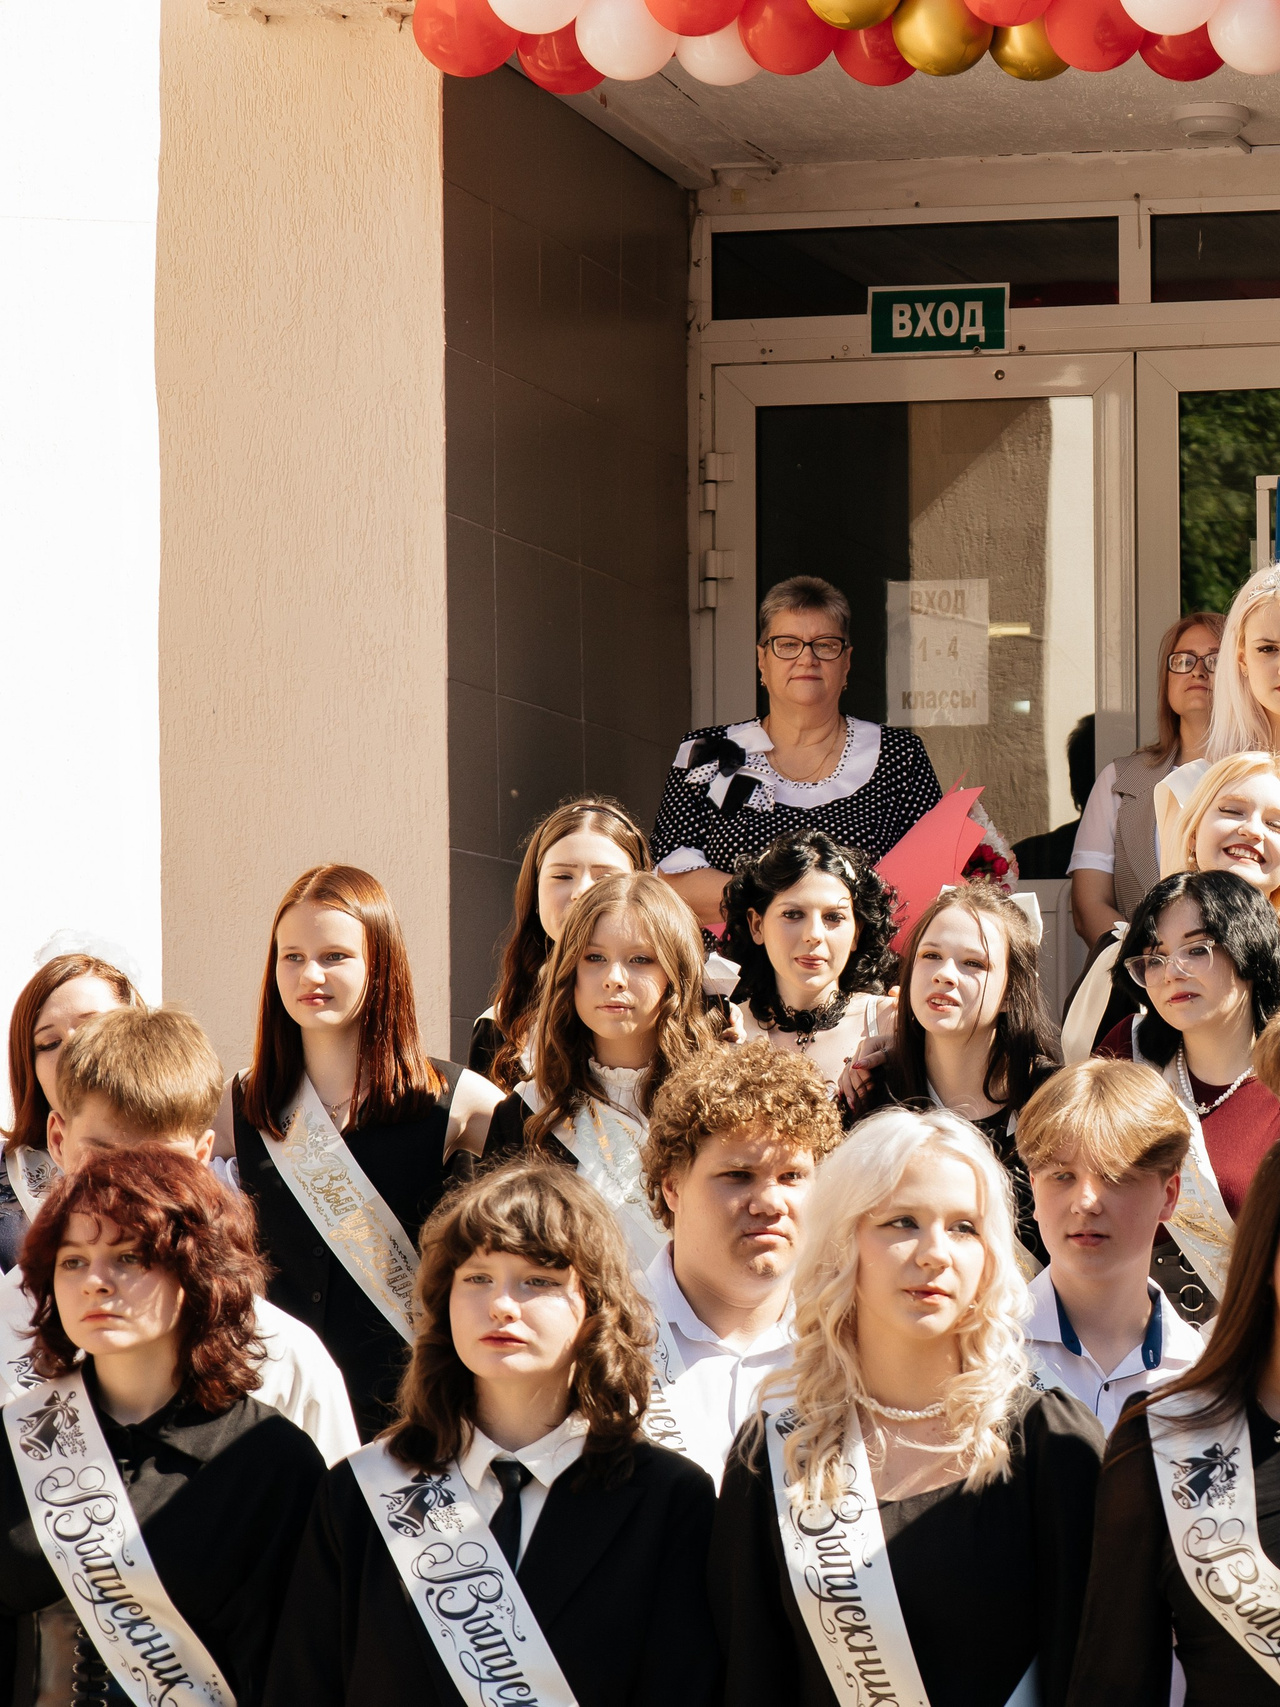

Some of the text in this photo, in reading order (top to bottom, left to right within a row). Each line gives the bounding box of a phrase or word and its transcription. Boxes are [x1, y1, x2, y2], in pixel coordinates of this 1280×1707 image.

[892, 301, 985, 343] ВХОД
[910, 589, 966, 618] ВХОД
[902, 690, 977, 709] классы
[35, 1466, 193, 1707] Выпускник
